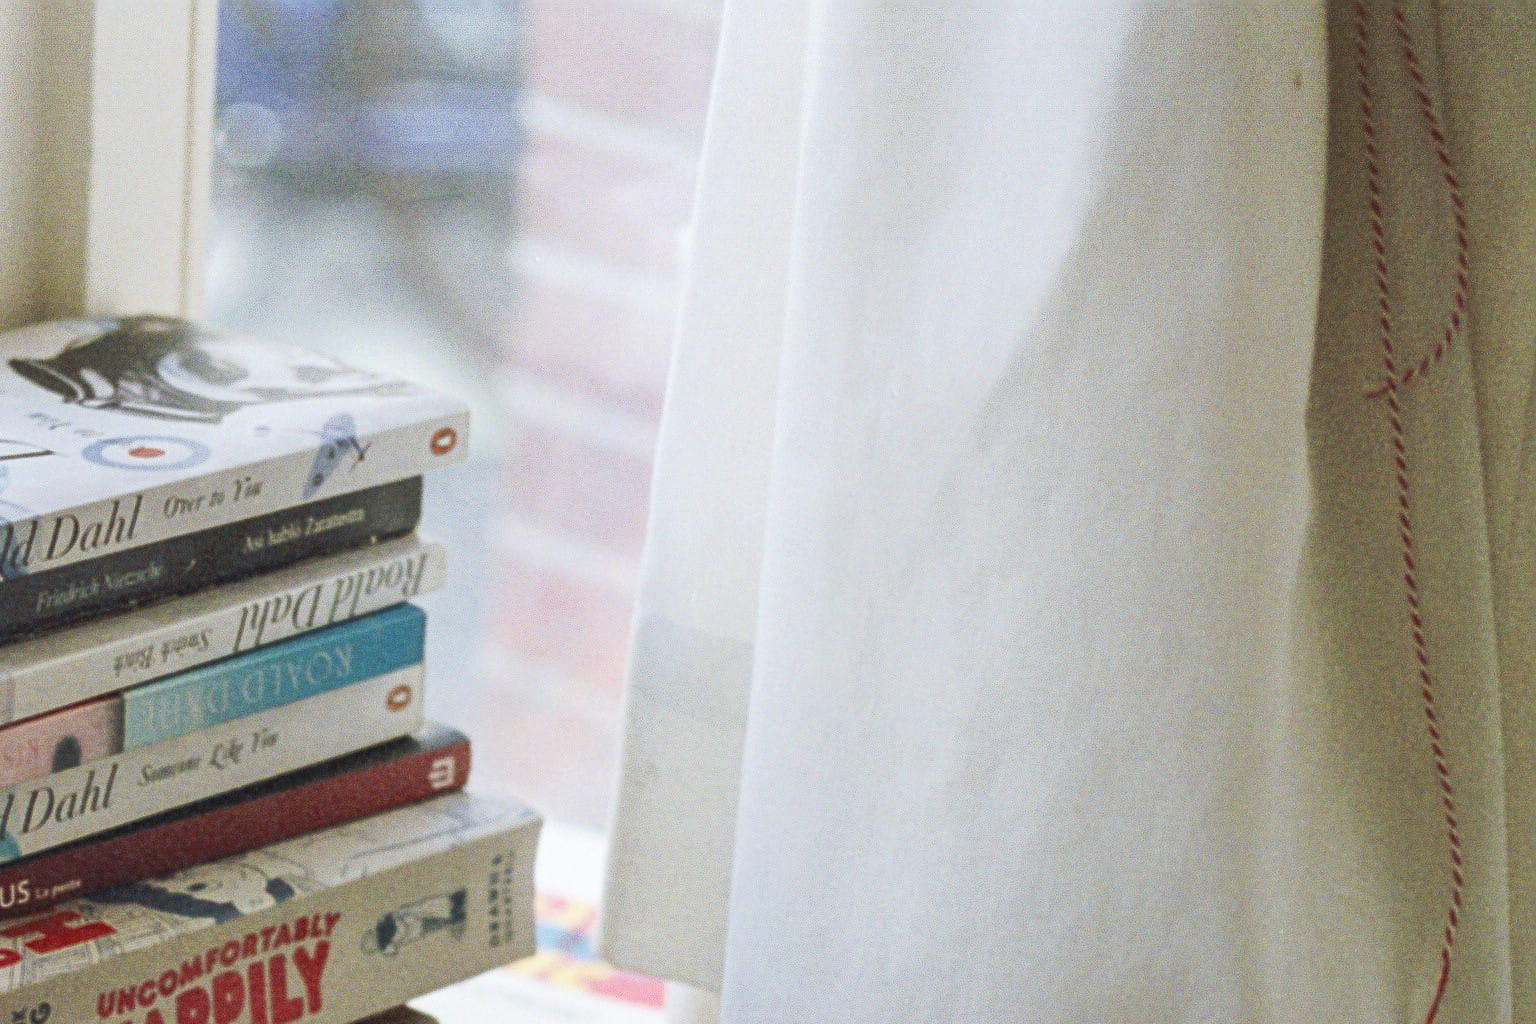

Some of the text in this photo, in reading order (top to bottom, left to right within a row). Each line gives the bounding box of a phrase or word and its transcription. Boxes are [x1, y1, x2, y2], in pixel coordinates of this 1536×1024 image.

[45, 494, 144, 562] Dahl
[163, 476, 264, 519] Over to You
[233, 552, 429, 649] Roald Dahl
[249, 645, 355, 702] ROALD
[22, 764, 118, 832] Dahl
[96, 912, 341, 1017] UNCOMFORTABLY
